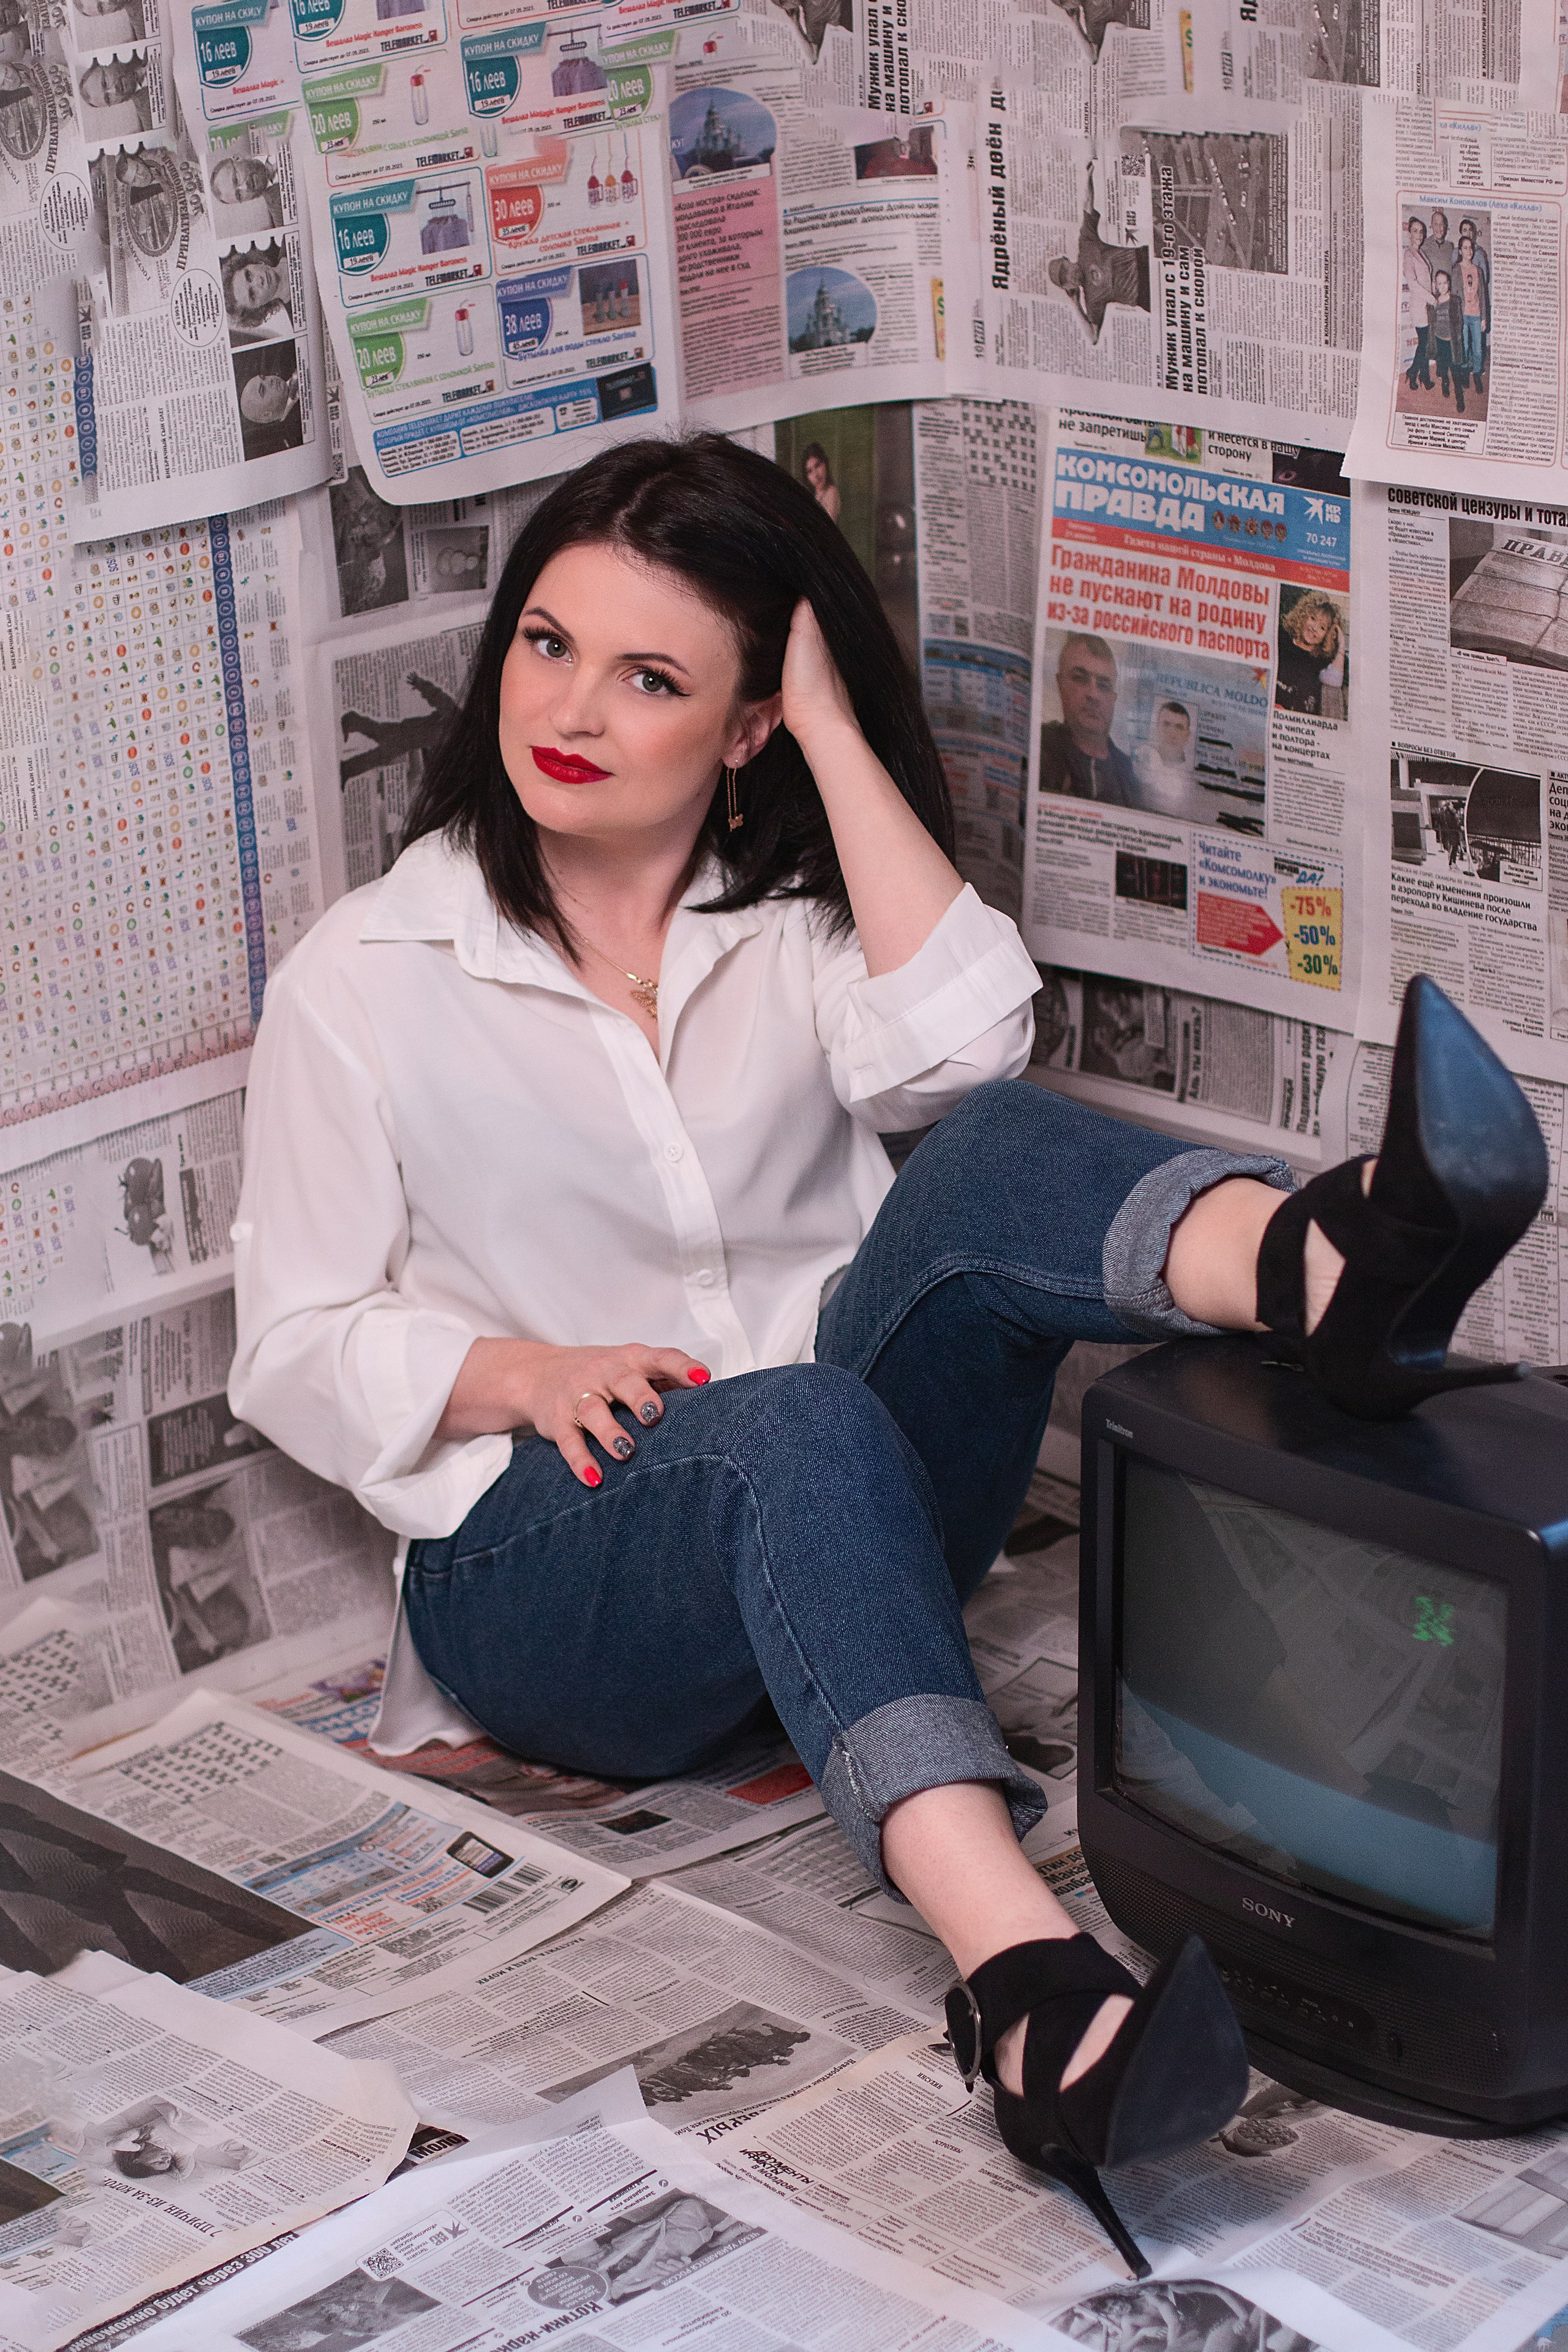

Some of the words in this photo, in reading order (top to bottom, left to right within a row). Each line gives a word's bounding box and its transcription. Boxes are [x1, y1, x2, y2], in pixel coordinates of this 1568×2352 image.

[195, 13, 222, 26] КУПОН
[225, 11, 238, 21] НА
[200, 43, 211, 62] 16
[214, 41, 237, 59] леев
[464, 43, 491, 56] КУПОН
[493, 41, 505, 50] НА
[507, 34, 539, 50] СКИДКУ
[306, 85, 332, 98] КУПОН
[334, 82, 347, 92] НА
[348, 76, 376, 91] СКИДКУ
[470, 73, 481, 92] 16
[483, 71, 505, 90] леев
[312, 115, 326, 135] 20
[327, 111, 352, 132] леев
[489, 171, 516, 184] КУПОН
[518, 170, 530, 179] НА
[532, 164, 562, 178] СКИДКУ
[334, 202, 361, 213] КУПОН
[363, 199, 374, 208] НА
[375, 192, 408, 205] СКИДКУ
[1161, 165, 1175, 219] этажа
[1419, 195, 1448, 205] Максим
[1449, 197, 1487, 208] Коновалов
[494, 200, 507, 221] 30
[509, 199, 533, 217] леев
[339, 229, 350, 250] 16
[352, 228, 375, 247] леев
[989, 185, 1011, 290] Ядрёный
[1162, 223, 1176, 267] 19-го
[1179, 246, 1191, 281] сам
[497, 284, 523, 296] КУПОН
[524, 282, 535, 292] НА
[537, 276, 567, 288] СКИДКУ
[1165, 273, 1176, 283] с
[1192, 247, 1205, 308] скорой
[1180, 284, 1190, 296] и
[1165, 287, 1177, 328] упал
[1194, 313, 1205, 323] к
[505, 314, 516, 336] 38
[519, 313, 542, 331] леев
[1180, 300, 1193, 368] машину
[357, 348, 371, 369] 20
[372, 347, 396, 365] леев
[1166, 331, 1179, 391] Мужик
[1195, 327, 1208, 395] потопал
[1183, 372, 1194, 393] на
[1058, 418, 1076, 431] не
[1079, 420, 1147, 443] запретишь
[163, 439, 172, 478] ВНЕБРАЧНЫЙ
[1208, 444, 1252, 462] сторону
[1262, 441, 1268, 450] в
[1271, 441, 1301, 459] нашу
[1057, 453, 1284, 516] КОМСОМОЛЬСКАЯ
[1055, 480, 1205, 532] ПРАВДА
[1388, 487, 1458, 511] советской
[1461, 497, 1521, 519] цензуры
[1525, 508, 1532, 521] и
[1537, 508, 1568, 526] тота
[1306, 532, 1318, 544] 70
[1321, 535, 1337, 547] 247
[1051, 544, 1171, 587] Гражданина
[1178, 565, 1270, 606] Молдовы
[1050, 575, 1073, 595] не
[1079, 580, 1164, 612] пускают
[1169, 595, 1192, 616] на
[1197, 602, 1267, 636] родину
[1047, 600, 1087, 625] из-за
[1092, 608, 1193, 646] российского
[1197, 624, 1271, 662] паспорта
[1273, 710, 1338, 732] Полмиллиарда
[1273, 723, 1282, 731] на
[1284, 724, 1316, 738] чипсах
[1272, 742, 1282, 751] на
[1284, 744, 1331, 760] концертах
[1280, 733, 1315, 747] полтора
[1398, 742, 1422, 752] ВОПРОСЫ
[1434, 749, 1457, 758] ОТВЕТОВ
[1199, 840, 1242, 863] Читайте
[1199, 858, 1276, 887] «Комсомолку»
[1208, 878, 1268, 900] экономьте!
[1390, 872, 1415, 886] Какие
[1417, 877, 1434, 891] ещё
[1436, 883, 1482, 899] изменения
[1483, 892, 1531, 910] произошли
[1290, 895, 1332, 918] -75%
[1398, 885, 1441, 903] аэропорту
[1442, 894, 1485, 912] Кишинева
[1487, 905, 1512, 916] после
[1391, 895, 1430, 911] перехода
[1432, 902, 1442, 911] во
[1444, 905, 1483, 921] владение
[1485, 913, 1537, 932] государства
[1294, 925, 1336, 946] -50%
[1297, 954, 1339, 976] -30%
[1106, 1419, 1133, 1438] Trinitron
[1242, 1897, 1296, 1928] SONY
[916, 2071, 944, 2090] ИНСУЛИН
[408, 2133, 467, 2159] Моло
[758, 2167, 798, 2194] МОЛДОВЕ
[135, 2189, 164, 2212] ИЗ-ЗА
[623, 2185, 650, 2203] выдавала
[609, 2200, 624, 2211] кота
[165, 2203, 209, 2235] ПРИЧИН,
[389, 2230, 413, 2247] правды»
[392, 2222, 439, 2250] «Комсомольской
[397, 2242, 413, 2254] канал
[401, 2240, 429, 2257] телеграм-
[405, 2247, 428, 2261] Читайте
[689, 2241, 738, 2272] УДИВЛЯЕТСЯ
[153, 2281, 200, 2310] будет
[197, 2258, 244, 2291] через
[239, 2244, 273, 2266] 300
[269, 2229, 299, 2253] лет
[660, 2267, 691, 2288] РОССИЯ
